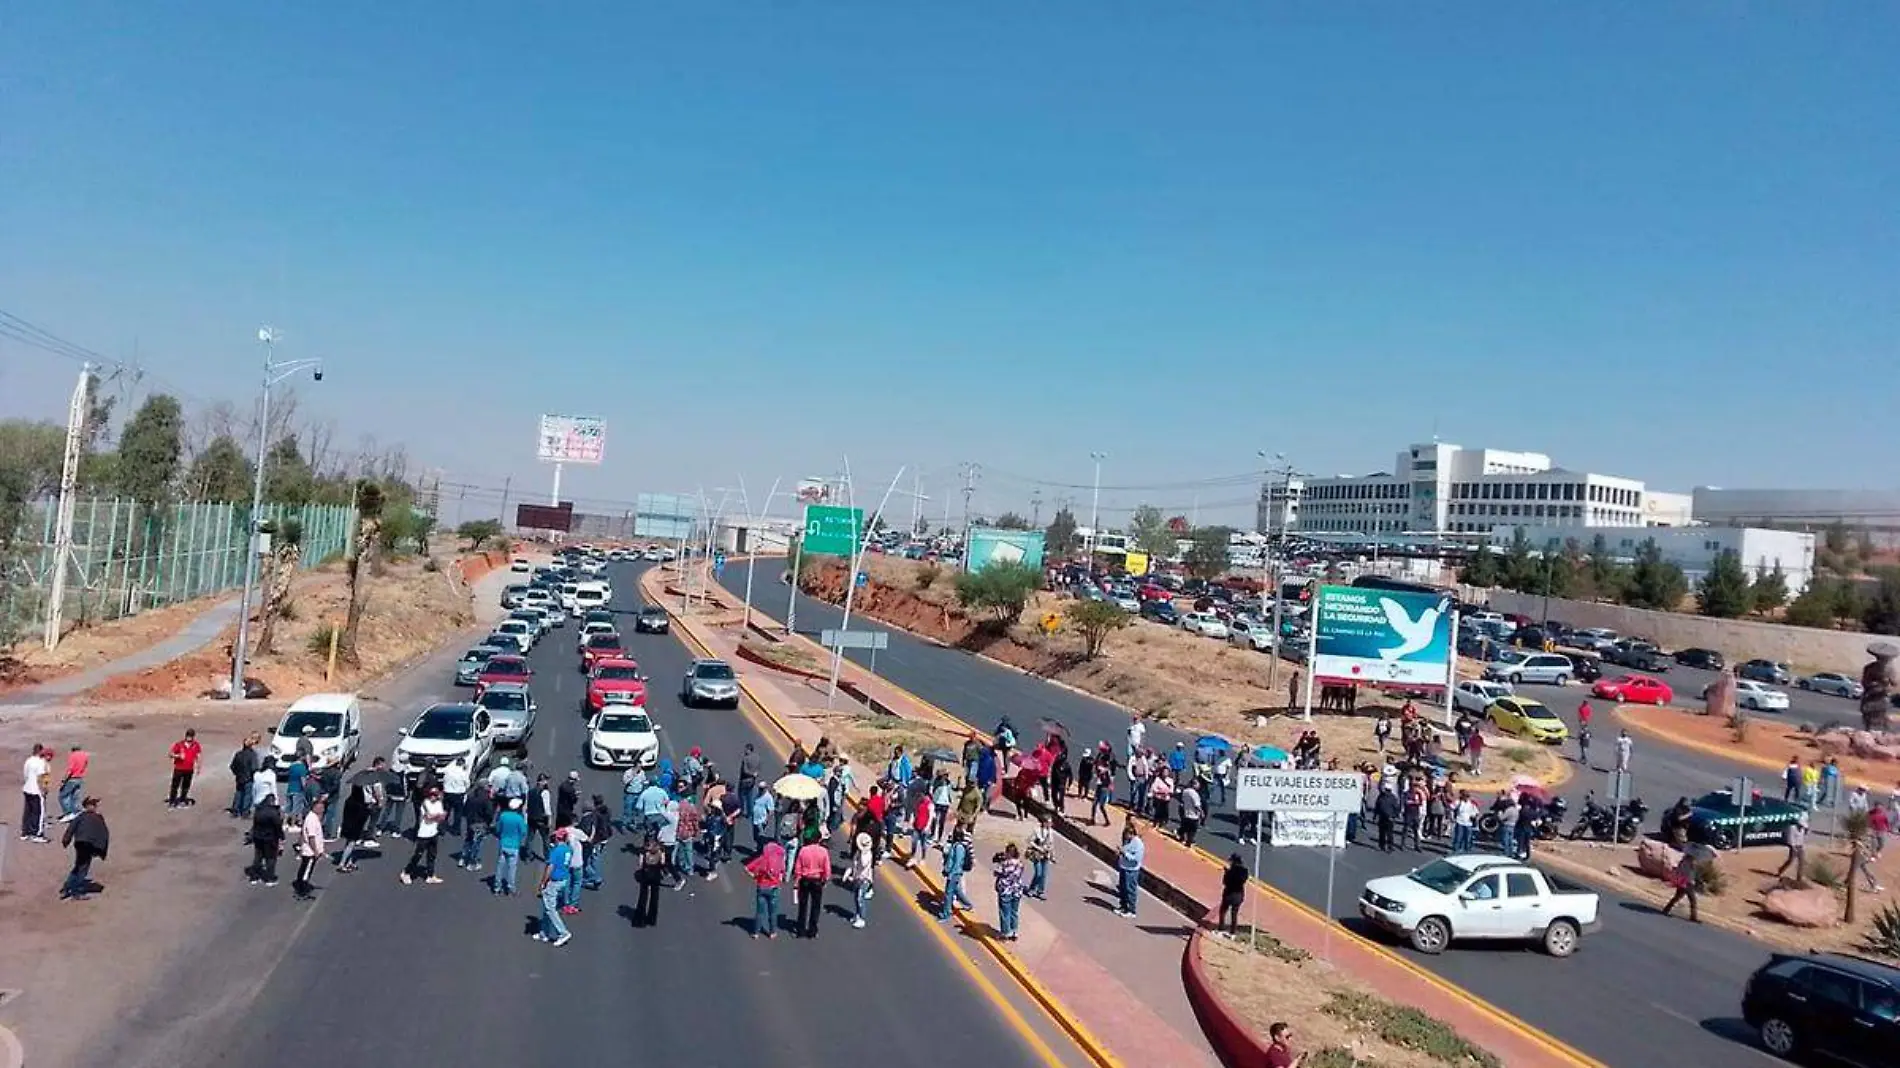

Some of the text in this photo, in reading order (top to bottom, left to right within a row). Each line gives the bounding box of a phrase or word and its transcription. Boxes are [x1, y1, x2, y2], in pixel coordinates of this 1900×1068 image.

[1325, 593, 1367, 604] ESTAMOS
[1324, 602, 1380, 615] MEJORANDO
[1323, 611, 1387, 624] LA SEGURIDAD
[1243, 775, 1358, 790] FELIZ VIAJE LES DESEA
[1269, 793, 1330, 806] ZACATECAS
